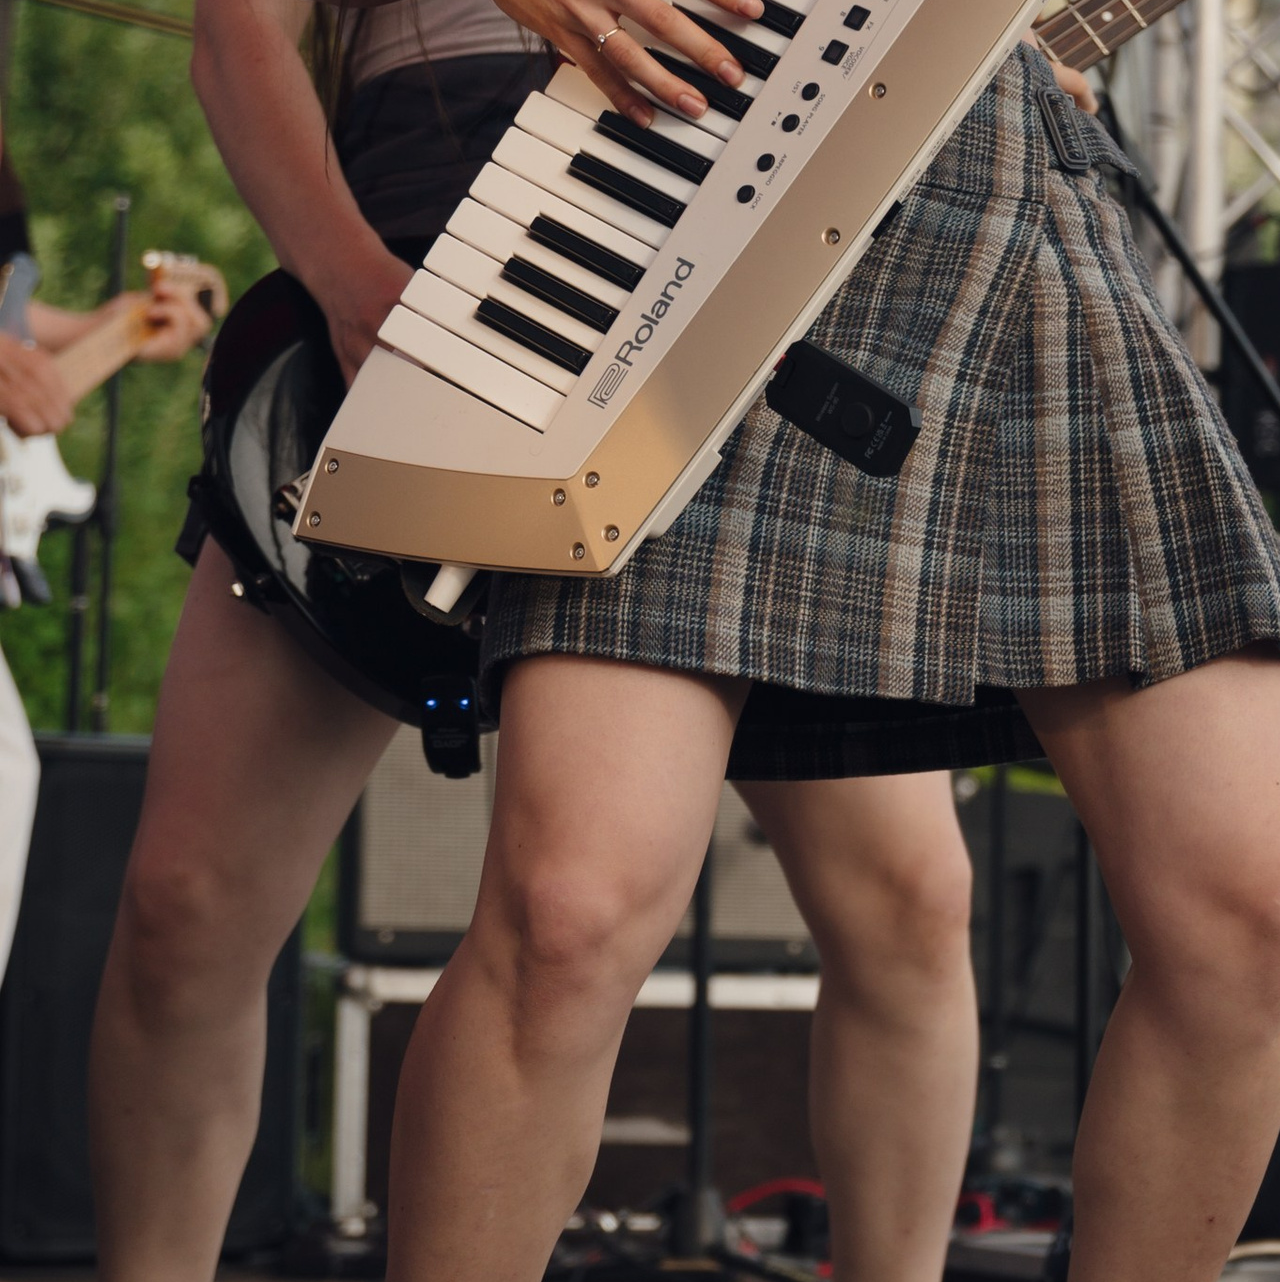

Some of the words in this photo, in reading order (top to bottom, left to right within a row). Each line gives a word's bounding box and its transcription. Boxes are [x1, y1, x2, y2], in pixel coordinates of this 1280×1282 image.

[865, 21, 873, 30] FX
[791, 80, 801, 94] LIST
[811, 93, 825, 111] SONG
[796, 112, 813, 135] PLAYER
[765, 153, 787, 186] ARPEGGIO
[749, 192, 763, 209] LOCK
[615, 257, 695, 367] Roland
